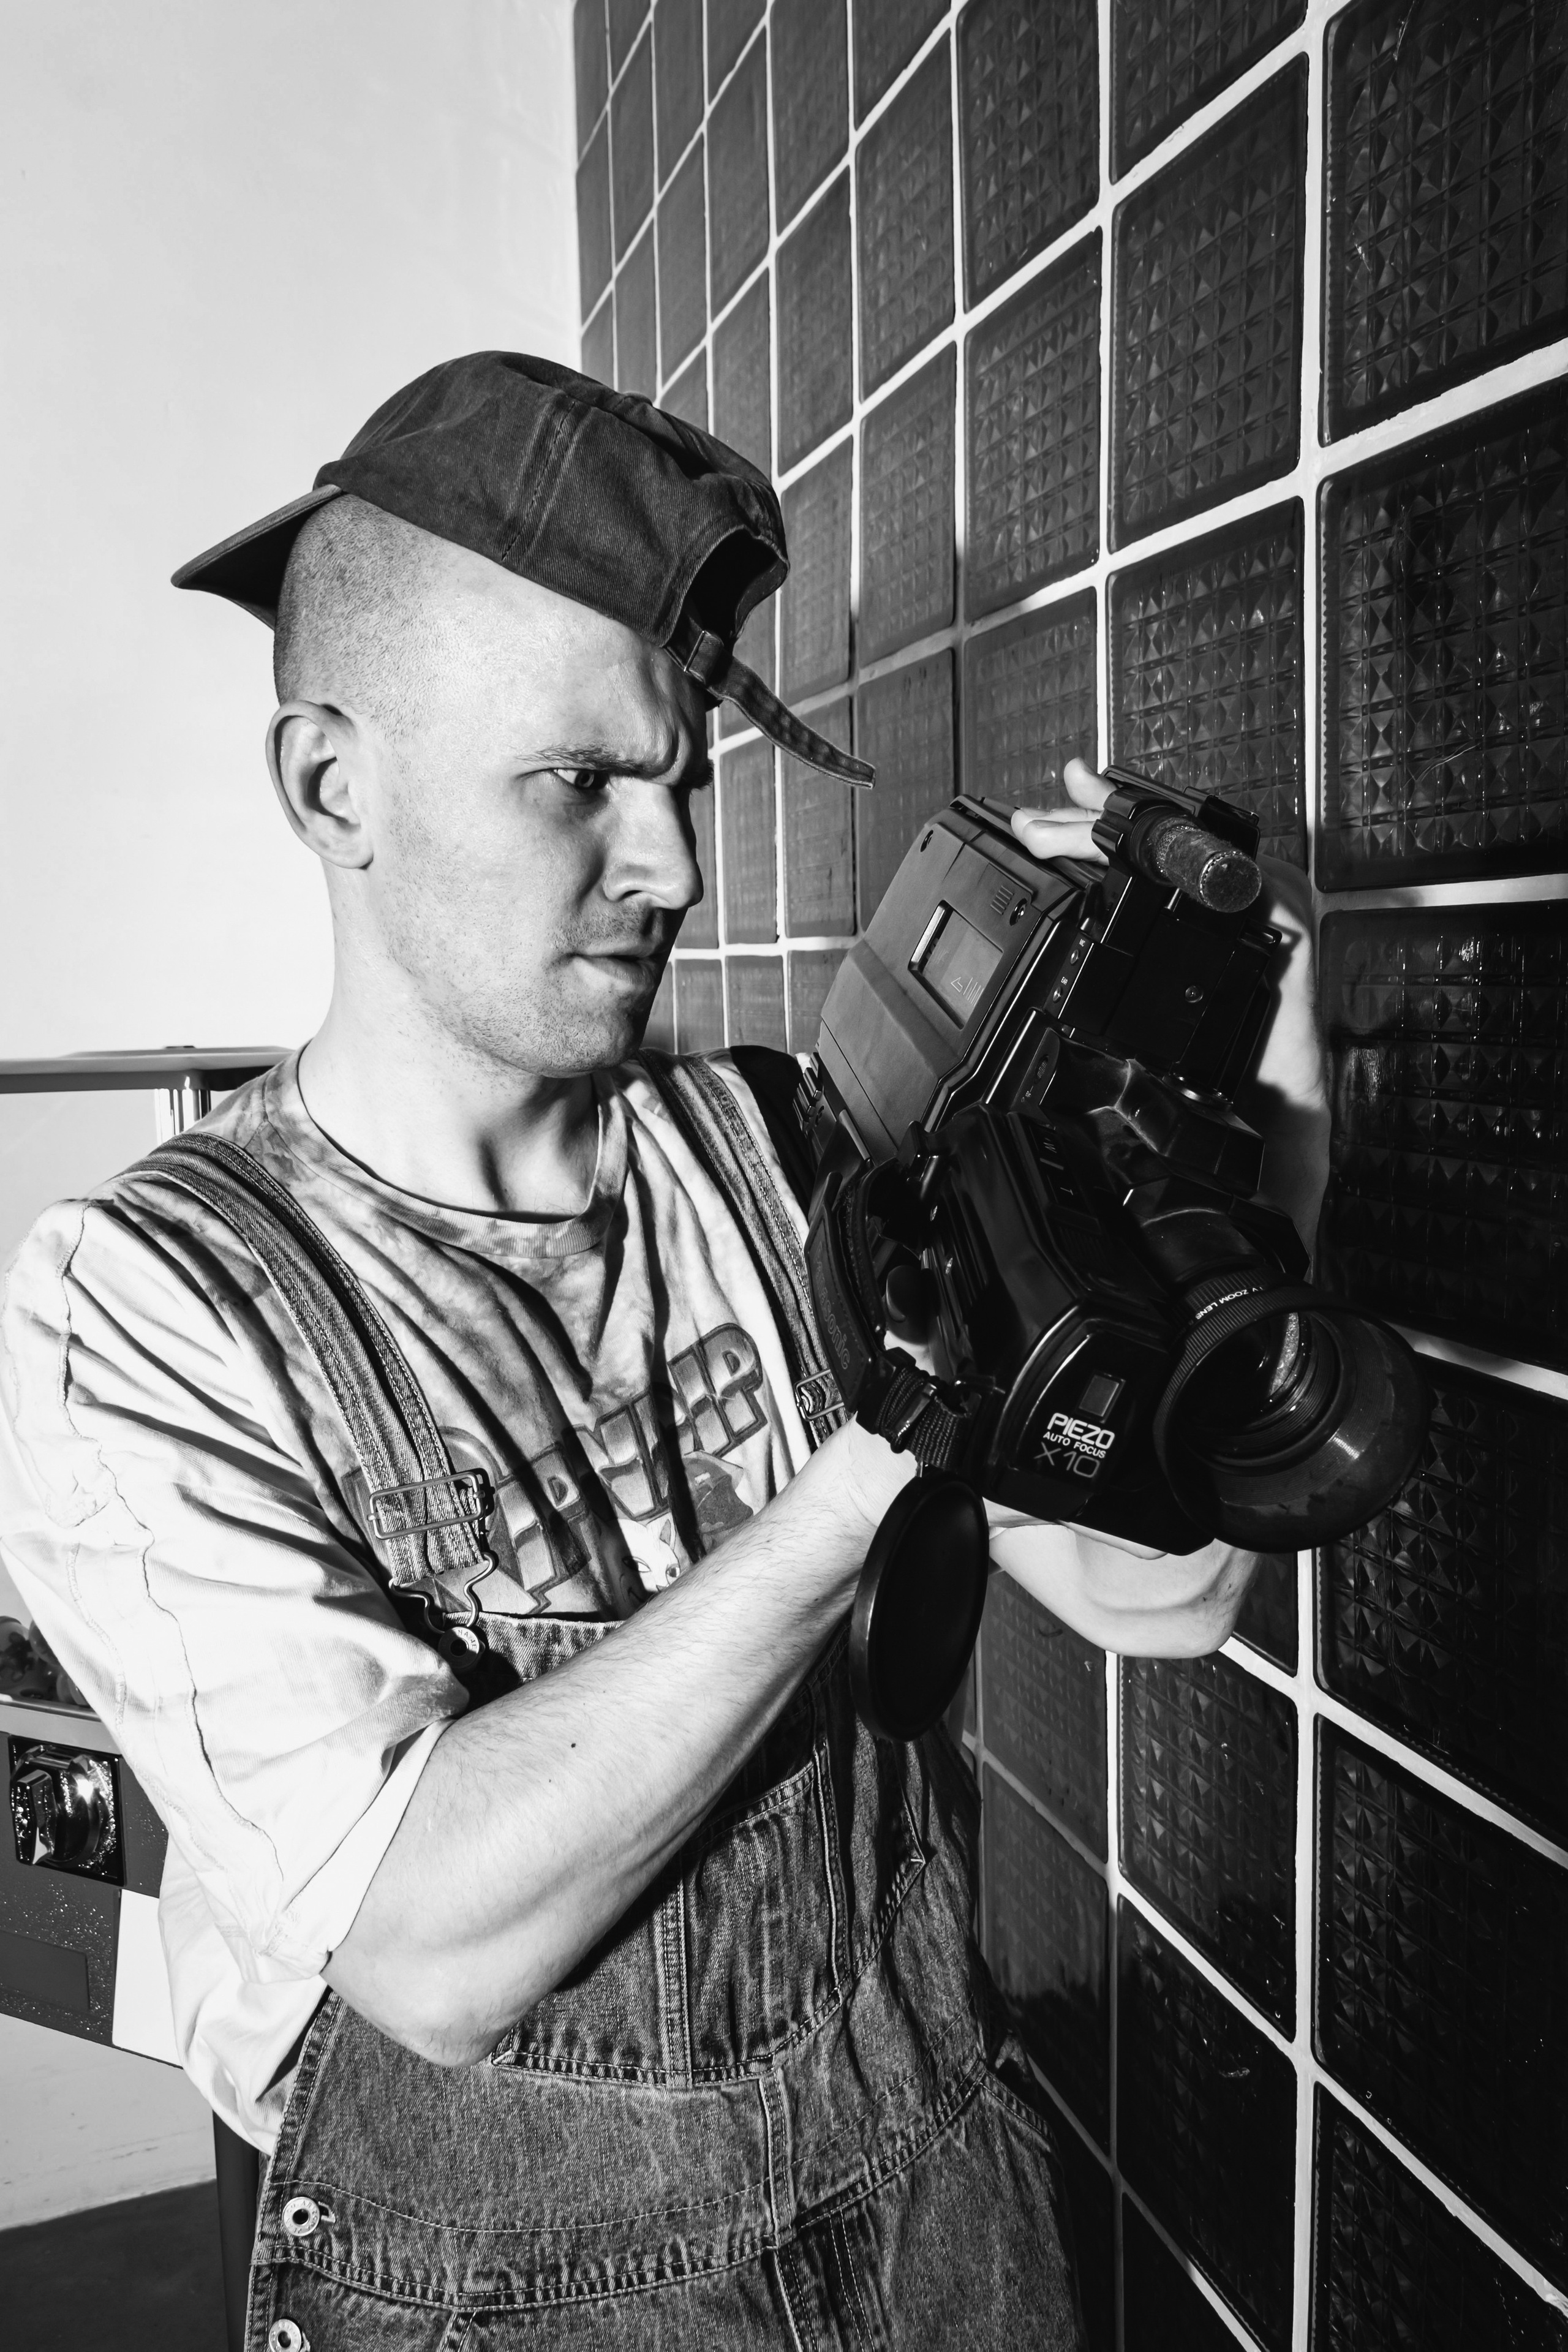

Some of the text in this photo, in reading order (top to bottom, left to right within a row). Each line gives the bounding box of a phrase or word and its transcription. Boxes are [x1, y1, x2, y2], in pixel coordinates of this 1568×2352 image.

[813, 1240, 851, 1370] Panasonic
[1194, 1302, 1218, 1321] LENS
[1218, 1289, 1250, 1305] ZOOM
[1042, 1431, 1107, 1459] AUTO FOCUS
[1046, 1412, 1115, 1450] PIEZO
[1033, 1441, 1101, 1479] X10
